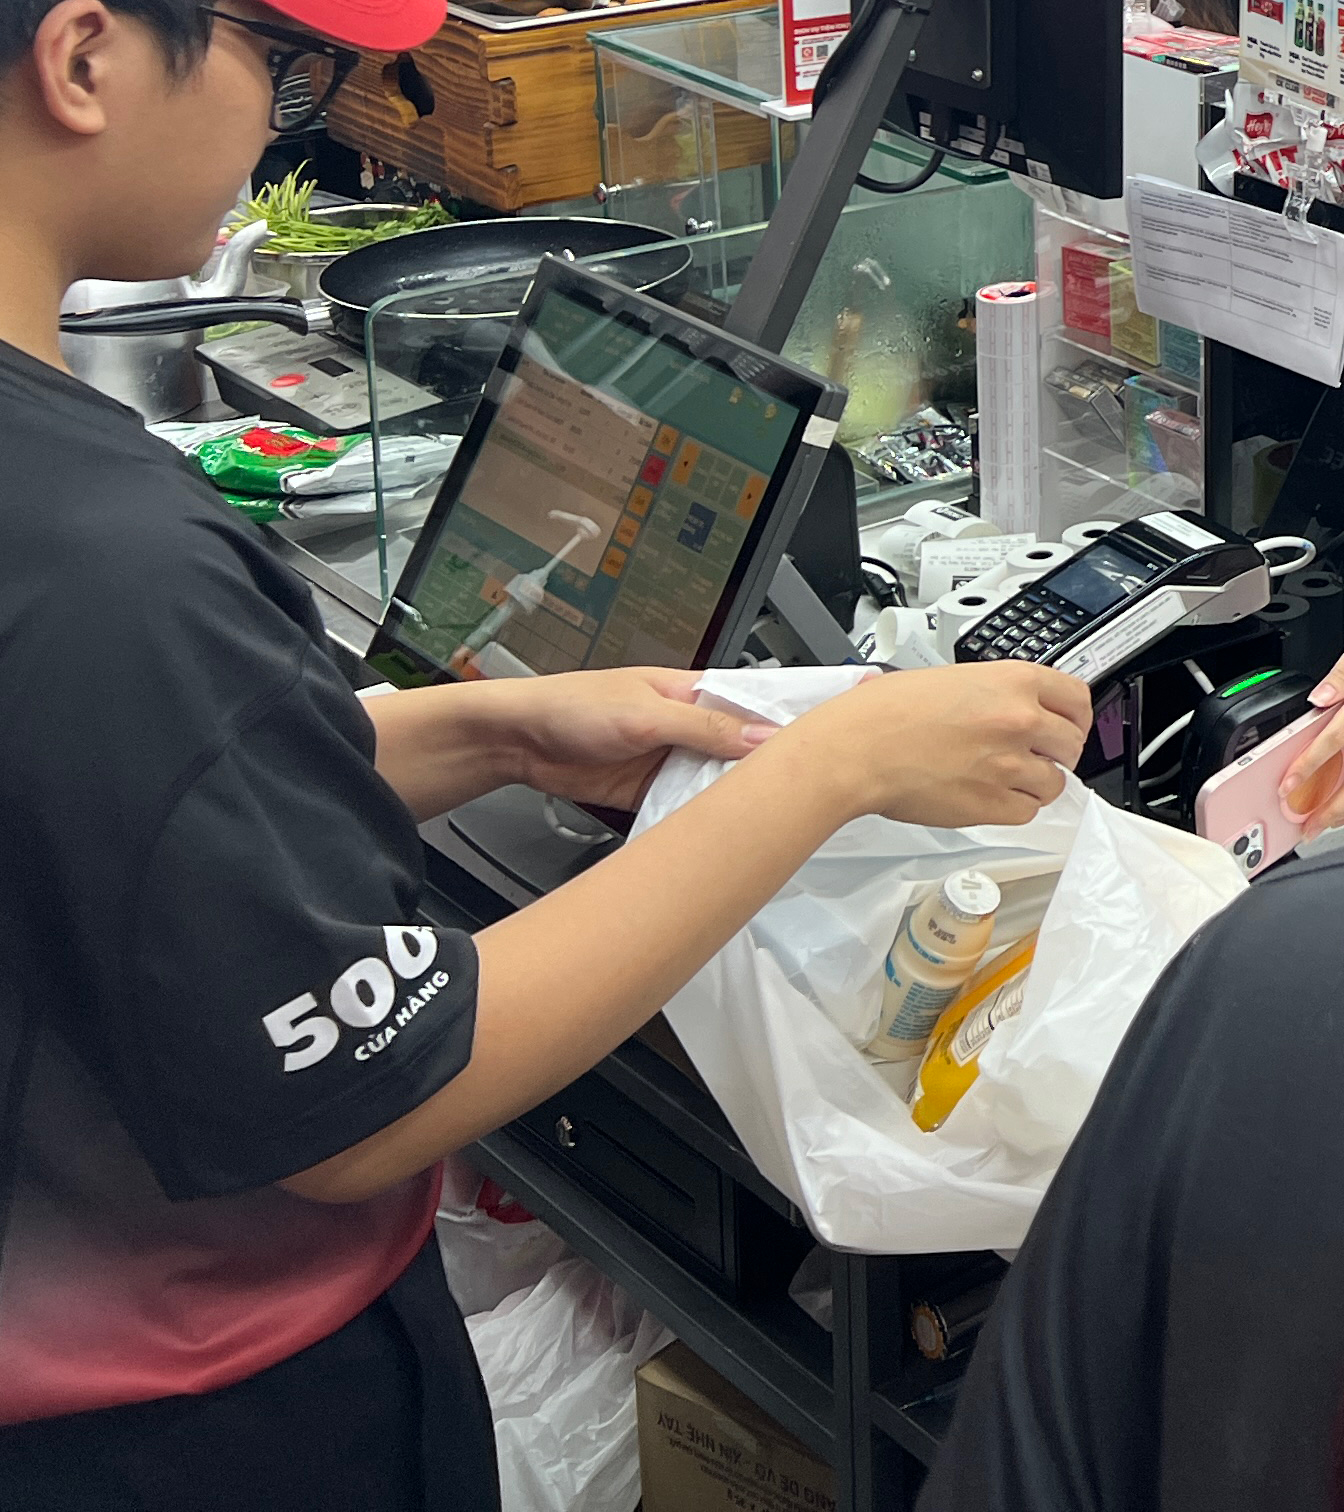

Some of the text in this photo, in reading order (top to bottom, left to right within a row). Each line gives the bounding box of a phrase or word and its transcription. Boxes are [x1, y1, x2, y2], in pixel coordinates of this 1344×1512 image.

[262, 925, 440, 1072] 500
[354, 970, 450, 1061] CỬA HÀNG
